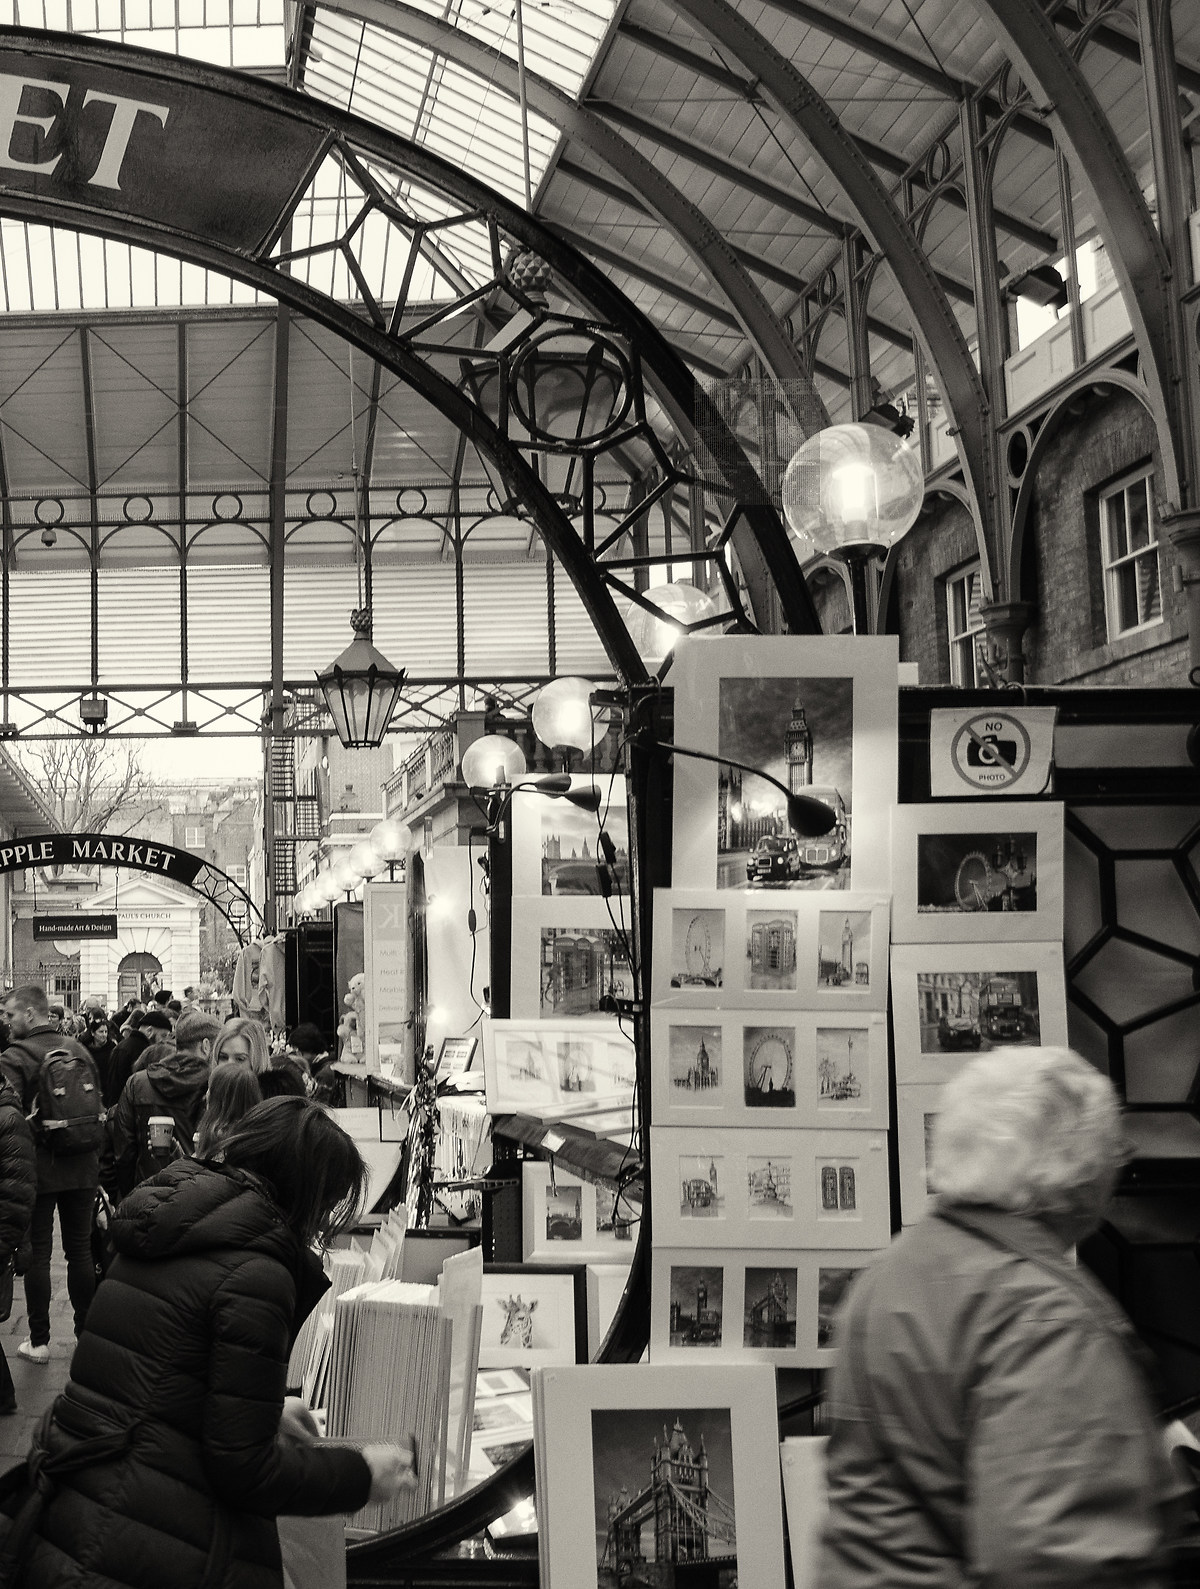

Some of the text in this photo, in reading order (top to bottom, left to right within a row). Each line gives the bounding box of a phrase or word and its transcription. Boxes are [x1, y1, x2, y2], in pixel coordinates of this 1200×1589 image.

[985, 722, 1003, 732] NO
[72, 840, 176, 871] MARKET
[39, 924, 74, 932] Hand-made
[91, 924, 112, 932] Design
